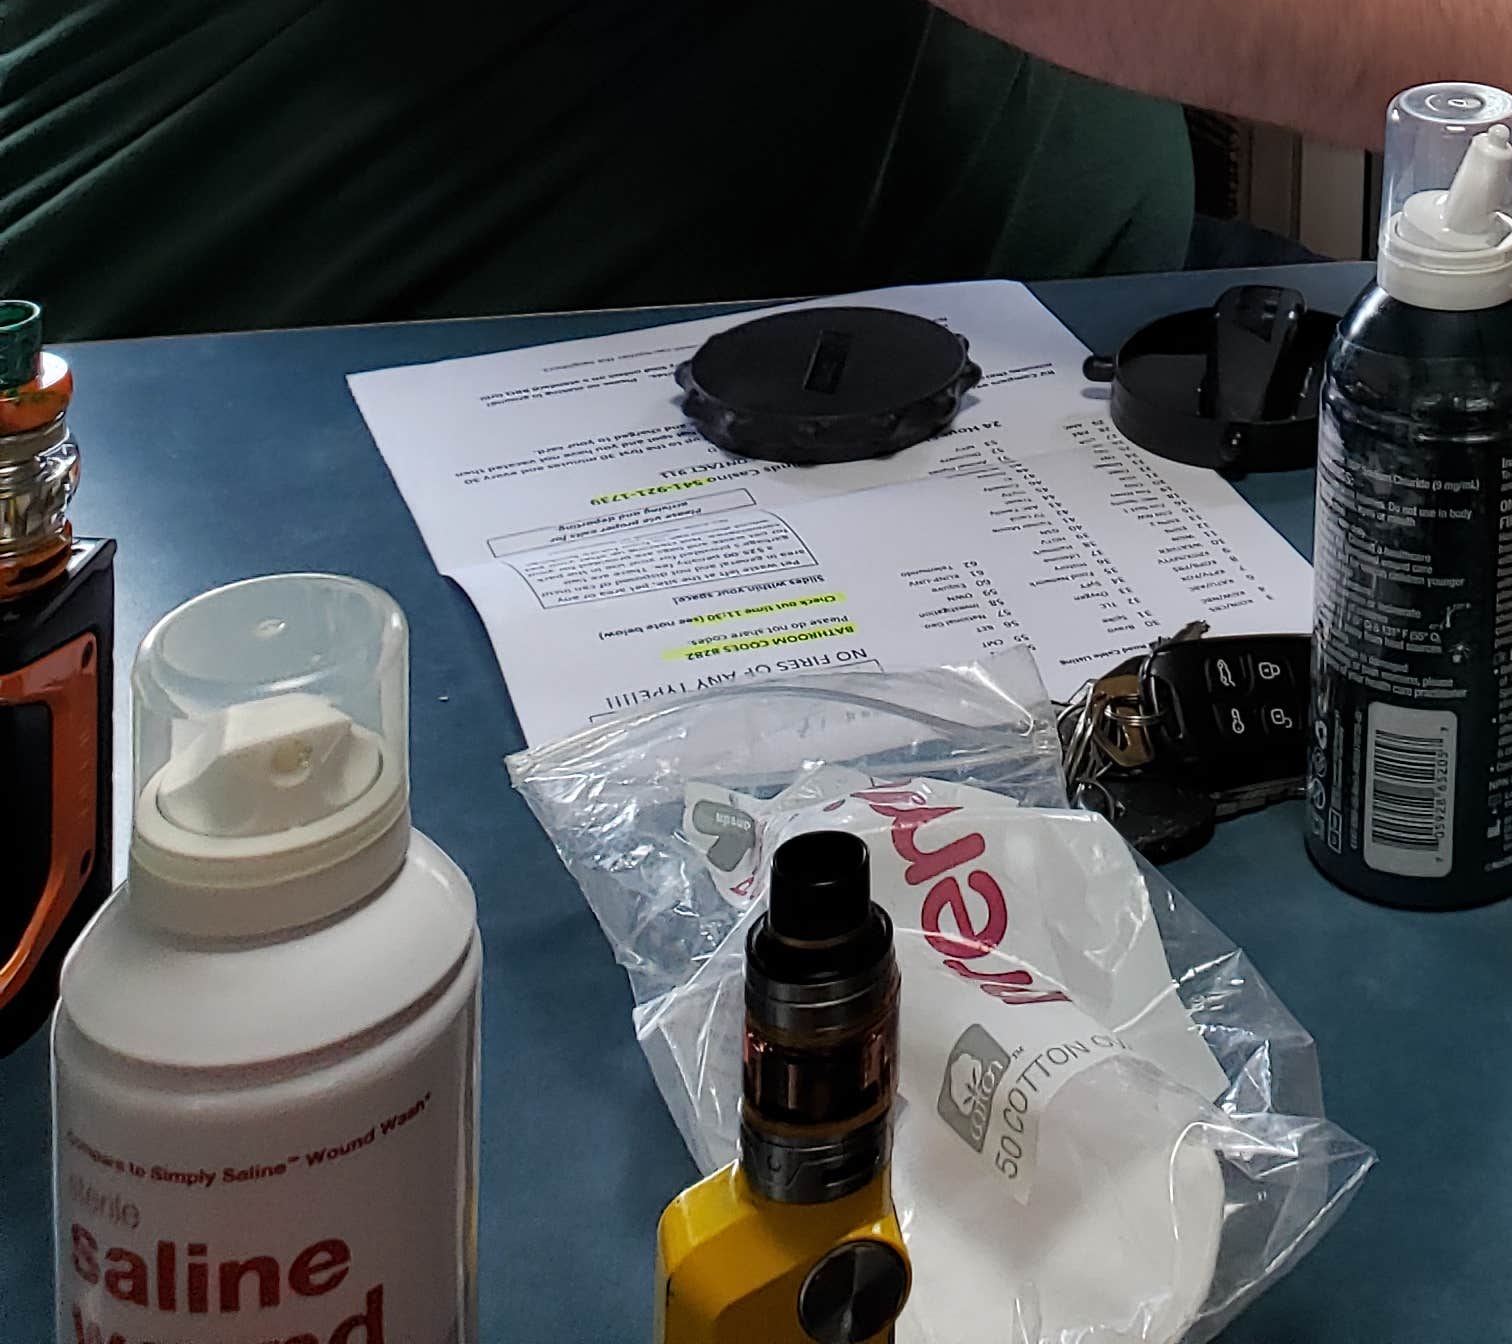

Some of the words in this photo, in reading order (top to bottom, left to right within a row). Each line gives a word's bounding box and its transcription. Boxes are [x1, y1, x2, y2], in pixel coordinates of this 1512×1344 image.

[658, 468, 688, 479] 911
[707, 468, 760, 484] Casino
[748, 580, 787, 593] within
[789, 574, 824, 588] Slides
[715, 584, 745, 597] your
[775, 600, 797, 610] out
[799, 594, 836, 608] Check
[707, 610, 741, 623] 11:30
[744, 604, 774, 616] time
[646, 619, 675, 632] note
[678, 613, 704, 626] (see
[791, 621, 806, 632] do
[809, 615, 848, 628] Please
[599, 625, 643, 641] below)
[730, 626, 764, 640] share
[766, 623, 788, 635] not
[772, 626, 854, 646] BATHROOM
[723, 640, 770, 654] CODES
[836, 648, 867, 662] NO
[776, 653, 830, 672] FIRES
[695, 670, 736, 690] ANY
[1003, 1039, 1091, 1134] COTTON
[127, 1161, 146, 1178] to
[150, 1164, 217, 1188] Simply
[305, 1127, 376, 1168] Wound
[995, 1135, 1023, 1180] 50
[71, 1222, 352, 1314] saline
